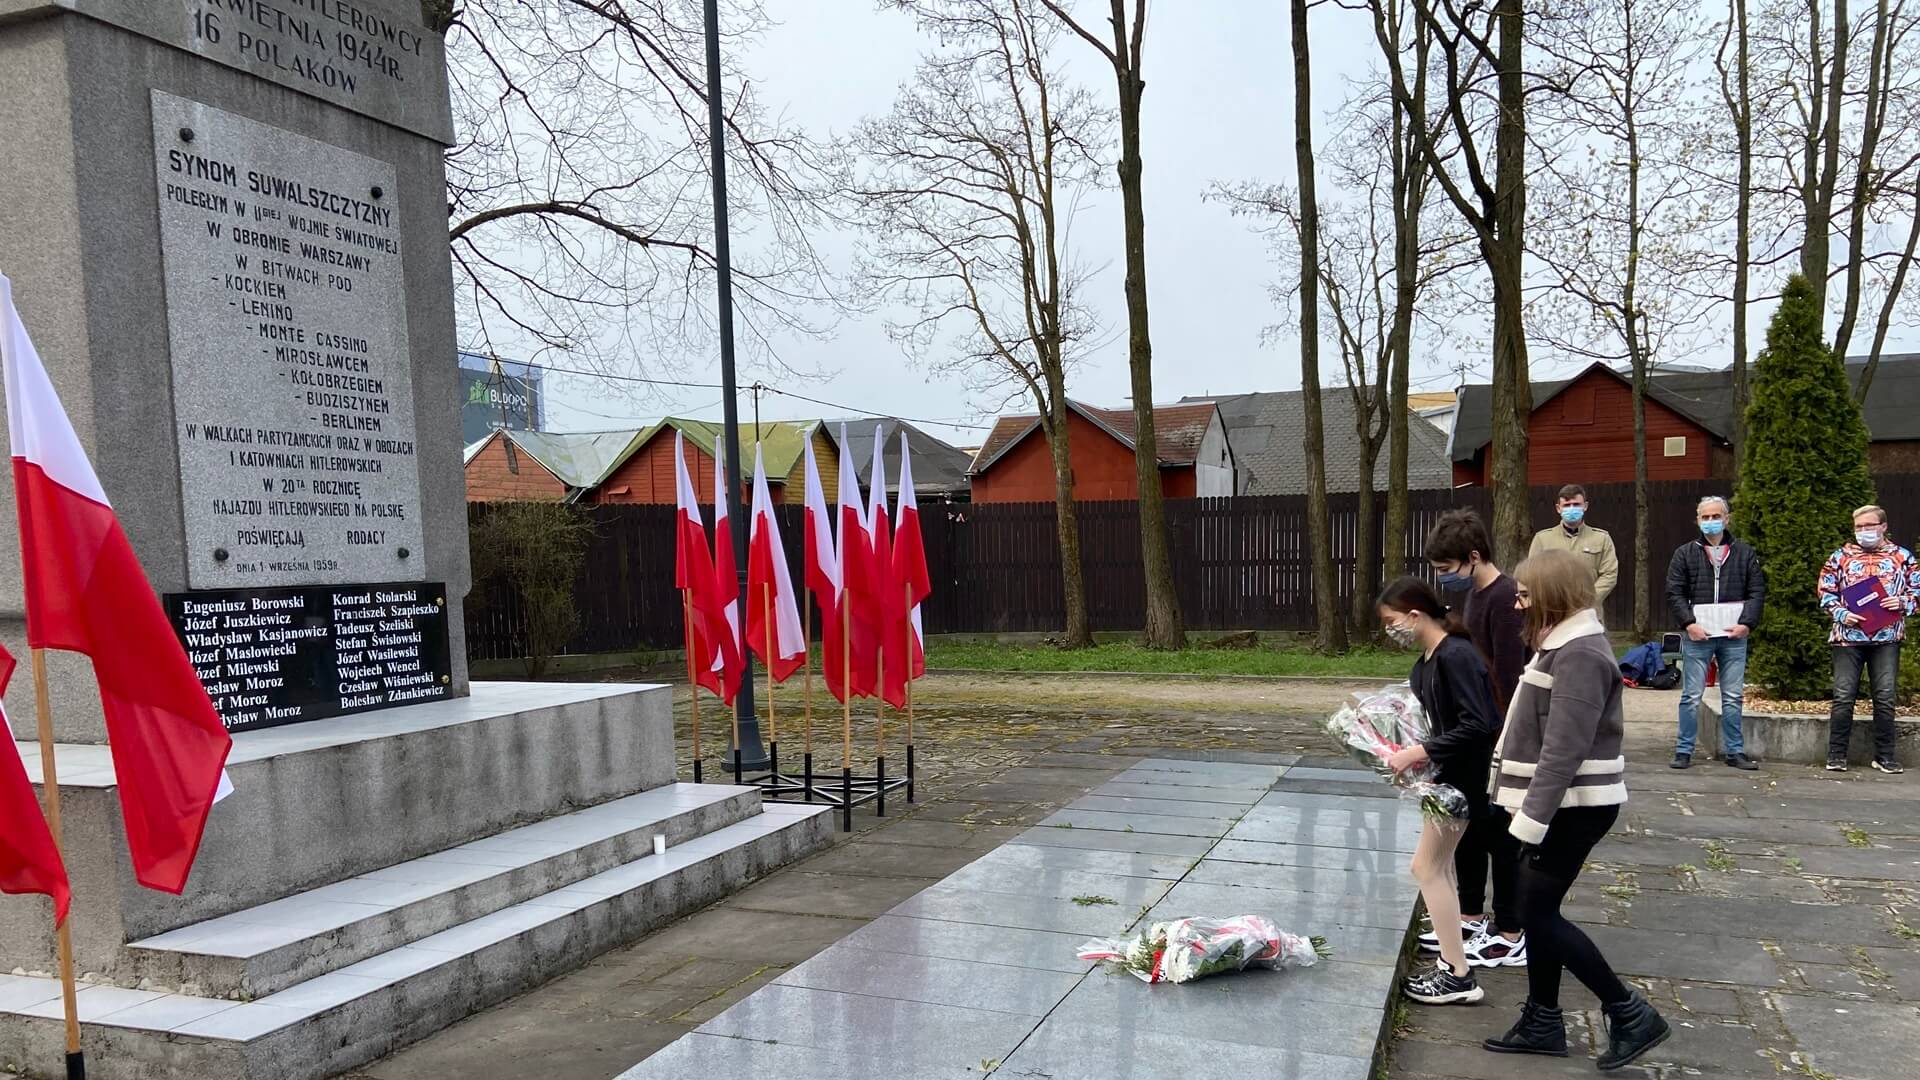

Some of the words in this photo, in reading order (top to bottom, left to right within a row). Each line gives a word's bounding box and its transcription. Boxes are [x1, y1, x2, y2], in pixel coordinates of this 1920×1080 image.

[194, 8, 221, 44] 16
[238, 31, 357, 94] POLAKÓW
[169, 149, 237, 187] SYNOM
[248, 171, 391, 228] SUWALSZCZYZNY
[167, 184, 228, 214] POLEGŁYM
[234, 200, 246, 218] W
[288, 214, 329, 238] WOJNIE
[335, 221, 398, 255] ŚWIATOWEJ
[206, 220, 221, 238] W
[233, 227, 290, 254] OBRONIE
[300, 242, 371, 272] WARSZAWY
[235, 254, 248, 270] W
[262, 260, 320, 285] BITWACH
[328, 274, 352, 292] POD
[225, 273, 286, 300] KOCKIEM
[242, 297, 293, 321] LENINO
[259, 323, 305, 343] MONTE
[316, 332, 368, 353] CASSINO
[276, 346, 369, 373] MIROSŁAWCEM
[291, 369, 383, 394] KOŁOBRZEGIEM
[306, 392, 389, 414] BUDZISZYNEM
[322, 413, 381, 432] BERLINEM
[186, 424, 197, 440] W
[203, 424, 252, 444] WALKACH
[257, 430, 331, 449] PARTYZANCKICH
[336, 436, 360, 451] ORAZ
[364, 438, 372, 453] W
[375, 439, 413, 456] OBOZACH
[239, 451, 304, 470] KATOWNIACH
[310, 455, 382, 473] HITLEROWSKICH
[263, 478, 274, 493] W
[312, 480, 362, 500] ROCZNICĘ
[213, 499, 262, 515] NAJAZDU
[269, 500, 349, 517] HITLEROWSKIEGO
[354, 503, 367, 517] NA
[371, 503, 405, 520] POLSKĘ
[237, 525, 306, 548] POŚWIĘCAJĄ
[347, 530, 386, 545] RODACY
[236, 563, 257, 574] DNIA
[269, 557, 310, 572] WRZEŚNIA
[184, 600, 246, 616] Eugeniusz
[252, 595, 304, 611] Borowski
[332, 592, 371, 606] Konrad
[375, 590, 417, 603] Stolarski
[184, 613, 217, 631] Józef
[223, 612, 291, 628] Juszkiewicz
[334, 606, 387, 621] Franciszek
[391, 604, 439, 620] Szapieszko
[186, 631, 251, 648] Władysław
[258, 625, 328, 644] Kasjanowicz
[334, 621, 375, 636] Tadeusz
[379, 618, 414, 632] Szeliski
[335, 635, 367, 650] Stefan
[188, 649, 219, 664] Józef
[336, 650, 363, 666] Józef
[367, 646, 419, 661] Wasilewski
[196, 665, 221, 679] ózef
[227, 659, 280, 677] Milewski
[338, 662, 382, 679] Wojciech
[387, 660, 420, 675] Wencel
[246, 677, 284, 690] Moroz
[338, 679, 378, 695] Czesław
[383, 671, 434, 689] Wiśniewski
[230, 694, 268, 708] Moroz
[341, 693, 383, 709] Bolesław
[388, 685, 444, 702] Zdankiewicz
[265, 706, 302, 720] Moroz
